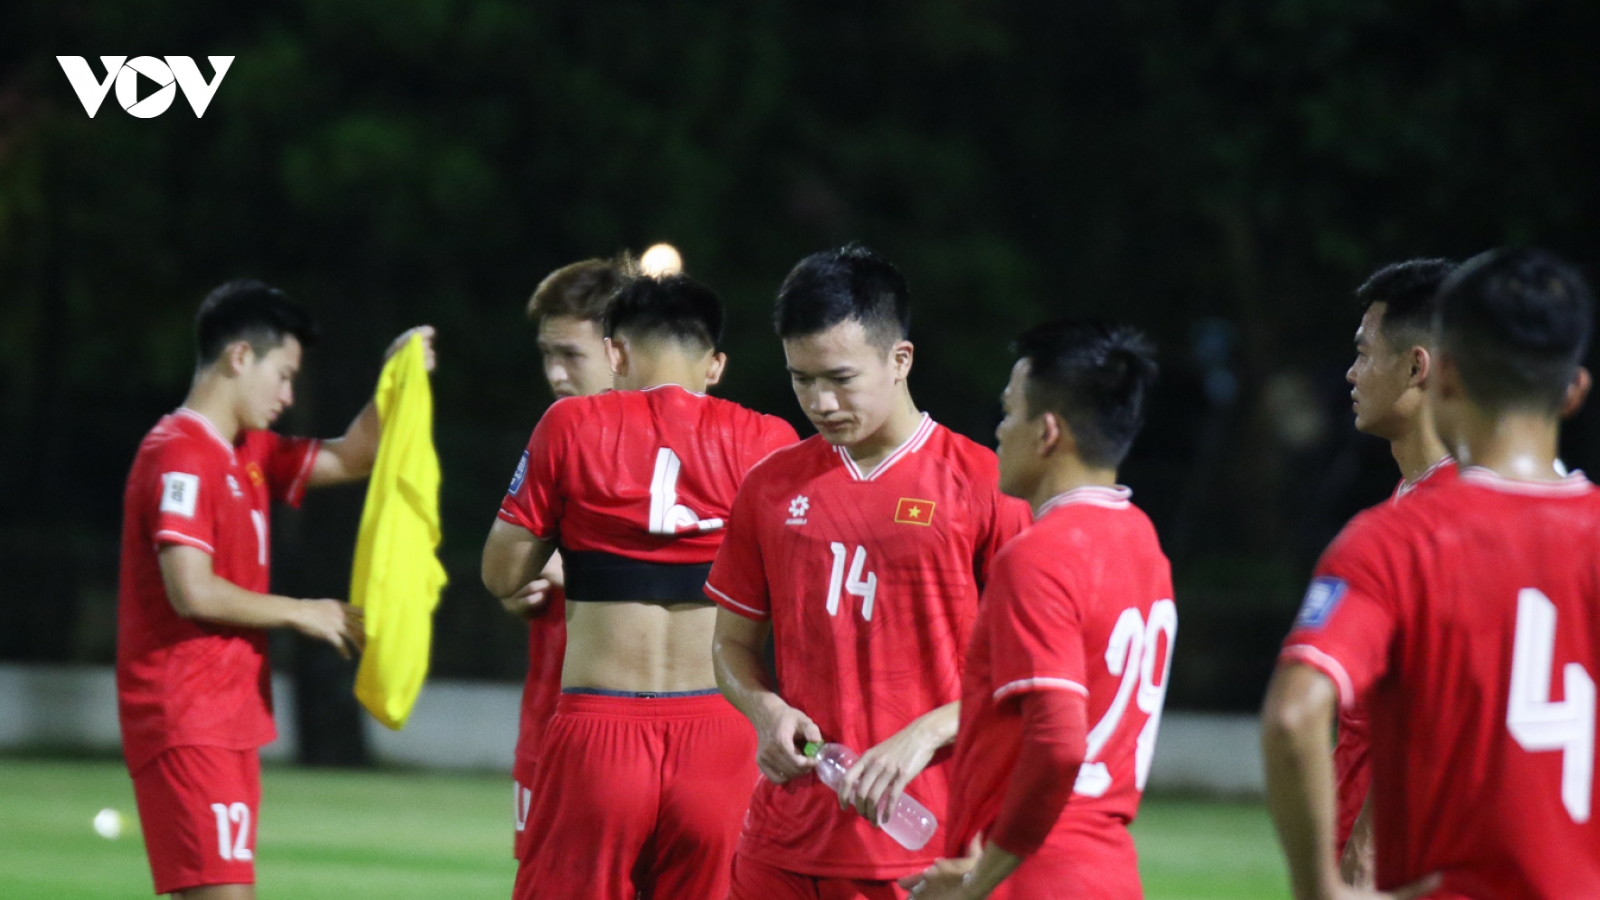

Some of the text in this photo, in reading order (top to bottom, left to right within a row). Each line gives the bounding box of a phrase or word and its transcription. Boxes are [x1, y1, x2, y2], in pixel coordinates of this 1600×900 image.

[826, 541, 878, 622] 14
[1072, 598, 1179, 798] 29
[1506, 587, 1597, 824] 4
[210, 802, 253, 861] 12
